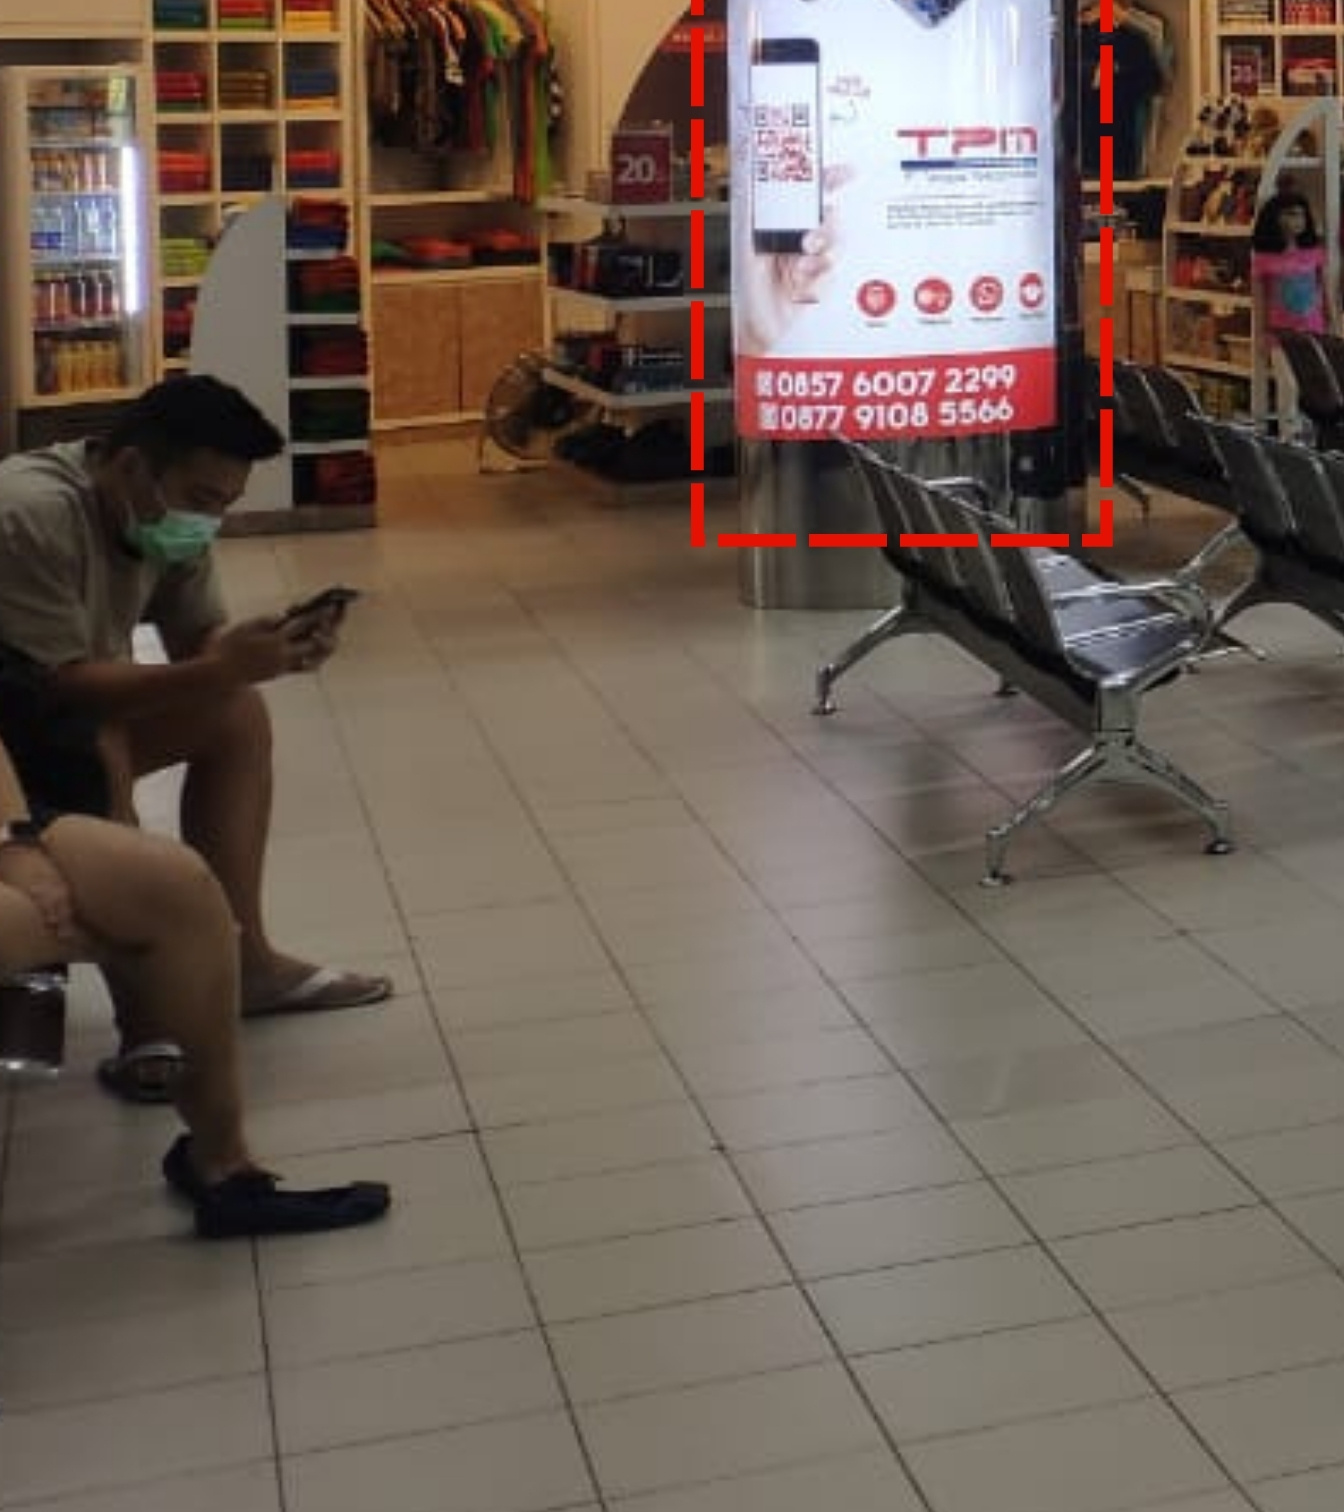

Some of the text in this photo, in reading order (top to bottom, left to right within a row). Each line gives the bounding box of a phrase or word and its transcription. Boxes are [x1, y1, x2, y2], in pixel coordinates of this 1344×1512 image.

[777, 364, 1017, 397] 0857 6007 2299
[780, 396, 1014, 431] 0877 9108 5566
